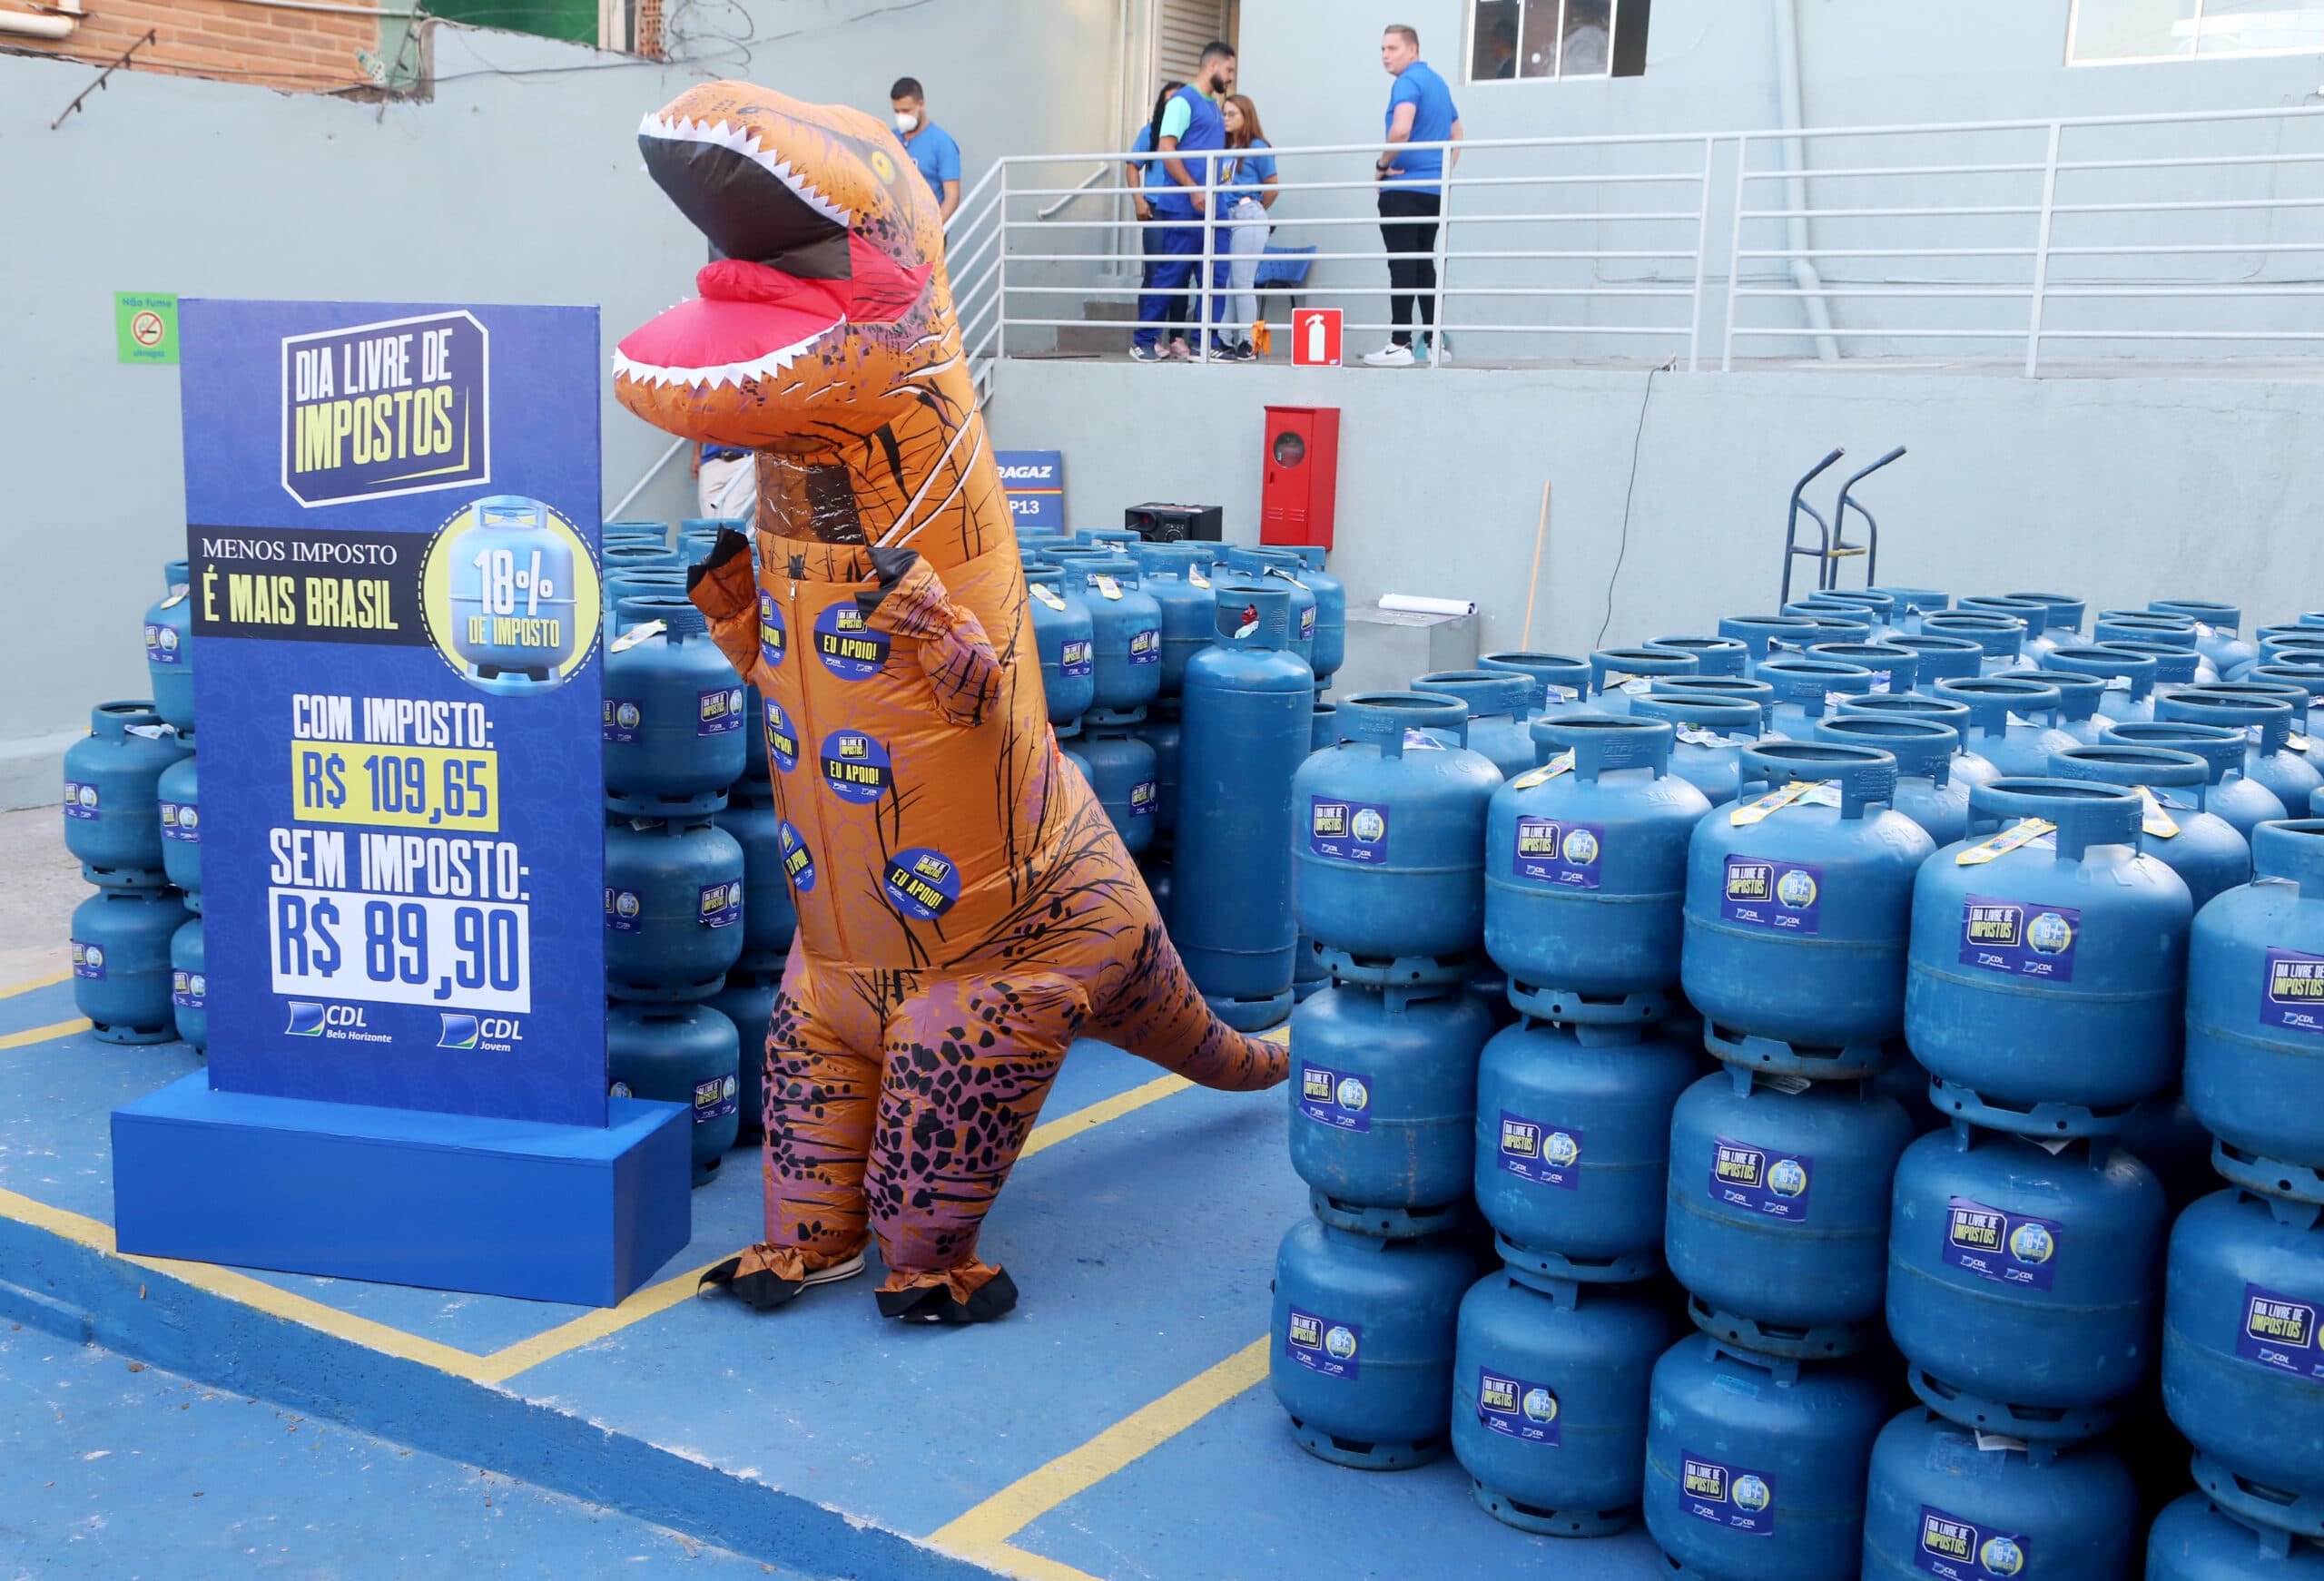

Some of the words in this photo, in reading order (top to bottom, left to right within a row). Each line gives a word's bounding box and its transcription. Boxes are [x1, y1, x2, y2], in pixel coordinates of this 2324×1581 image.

[295, 347, 334, 402] DIA
[344, 333, 413, 394] LIVRE
[422, 328, 453, 383] DE
[295, 385, 453, 473] IMPOSTOS
[202, 537, 286, 562] MENOS
[291, 541, 398, 565] IMPOSTO
[474, 549, 554, 616] 18%
[202, 564, 220, 622] É
[229, 574, 295, 625] MAIS
[305, 576, 399, 630] BRASIL
[468, 616, 487, 645] DE
[493, 617, 560, 647] IMPOSTO
[823, 634, 837, 653] EU
[841, 638, 877, 661] APOIO!
[292, 693, 353, 741] COM
[363, 697, 494, 749] IMPOSTO:
[830, 760, 842, 779] EU
[846, 764, 879, 785] APOIO!
[302, 751, 347, 810] R$
[363, 755, 487, 825] 109,65
[270, 827, 346, 889] SEM
[359, 832, 530, 900] IMPOSTO:
[891, 868, 910, 887] EU
[906, 879, 944, 909] APOIO!
[1728, 879, 1765, 893] IMPOSTOS
[1984, 909, 2004, 921] LIVRE
[2004, 909, 2014, 922] DE
[1970, 922, 2012, 938] IMPOSTOS
[277, 894, 341, 978] R$
[364, 899, 519, 1000] 89,90
[1990, 955, 2003, 964] CDL
[2290, 965, 2314, 978] LIVRE
[2315, 965, 2324, 978] DE
[2273, 977, 2324, 996] IMPOSTOS
[326, 1005, 367, 1027] CDL
[327, 1029, 347, 1040] Belo
[349, 1031, 392, 1044] Horizonte
[480, 1018, 523, 1040] CDL
[480, 1040, 511, 1053] Jovem
[1718, 1162, 1756, 1180] IMPOSTOS
[1968, 1213, 1986, 1227] LIVRE
[1987, 1216, 1999, 1229] DE
[1954, 1223, 1995, 1244] IMPOSTOS
[1974, 1260, 1986, 1269] CDL
[2019, 1272, 2034, 1280] CDL
[2269, 1303, 2293, 1320] LIVRE
[2291, 1307, 2305, 1321] DE
[2250, 1313, 2302, 1338] IMPOSTOS
[2273, 1352, 2290, 1363] CDL
[1925, 1530, 1966, 1555] IMPOSTOS
